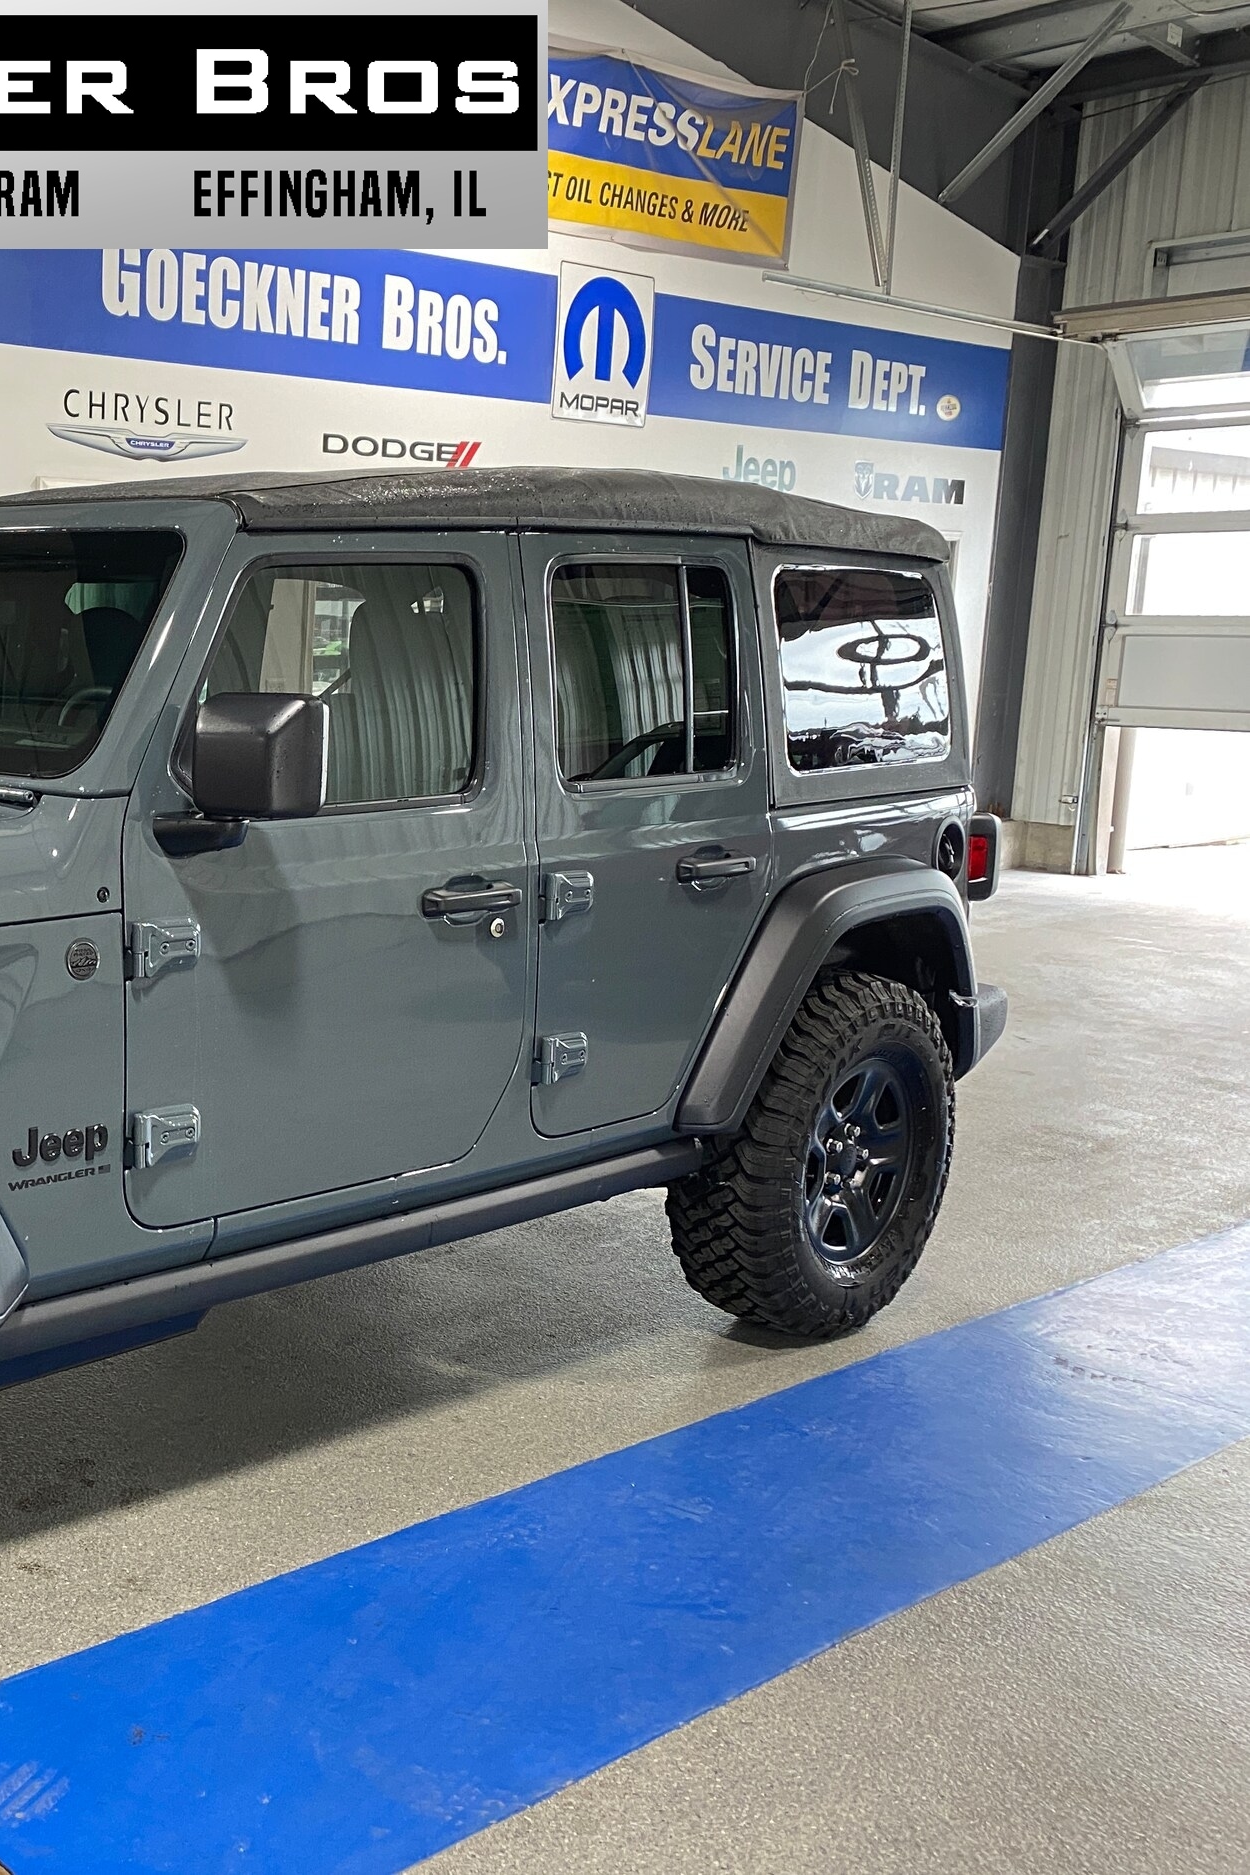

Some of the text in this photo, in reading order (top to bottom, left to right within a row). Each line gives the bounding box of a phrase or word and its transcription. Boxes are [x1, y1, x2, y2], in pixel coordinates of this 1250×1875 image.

[565, 175, 592, 204] OIL
[599, 181, 677, 220] CHANGES
[681, 198, 694, 223] &
[699, 202, 749, 232] MORE
[102, 249, 507, 365] GOECKNER BROS.
[689, 323, 927, 416] SERVICE DEPT.
[63, 388, 233, 431] CHRYSLER
[559, 391, 640, 417] MOPAR
[130, 439, 171, 449] CHRYSLER
[322, 432, 460, 463] DODGE
[722, 444, 797, 492] Jeep
[872, 472, 966, 505] RAM
[12, 1122, 109, 1168] Jeep
[8, 1167, 96, 1192] WRANGLER
